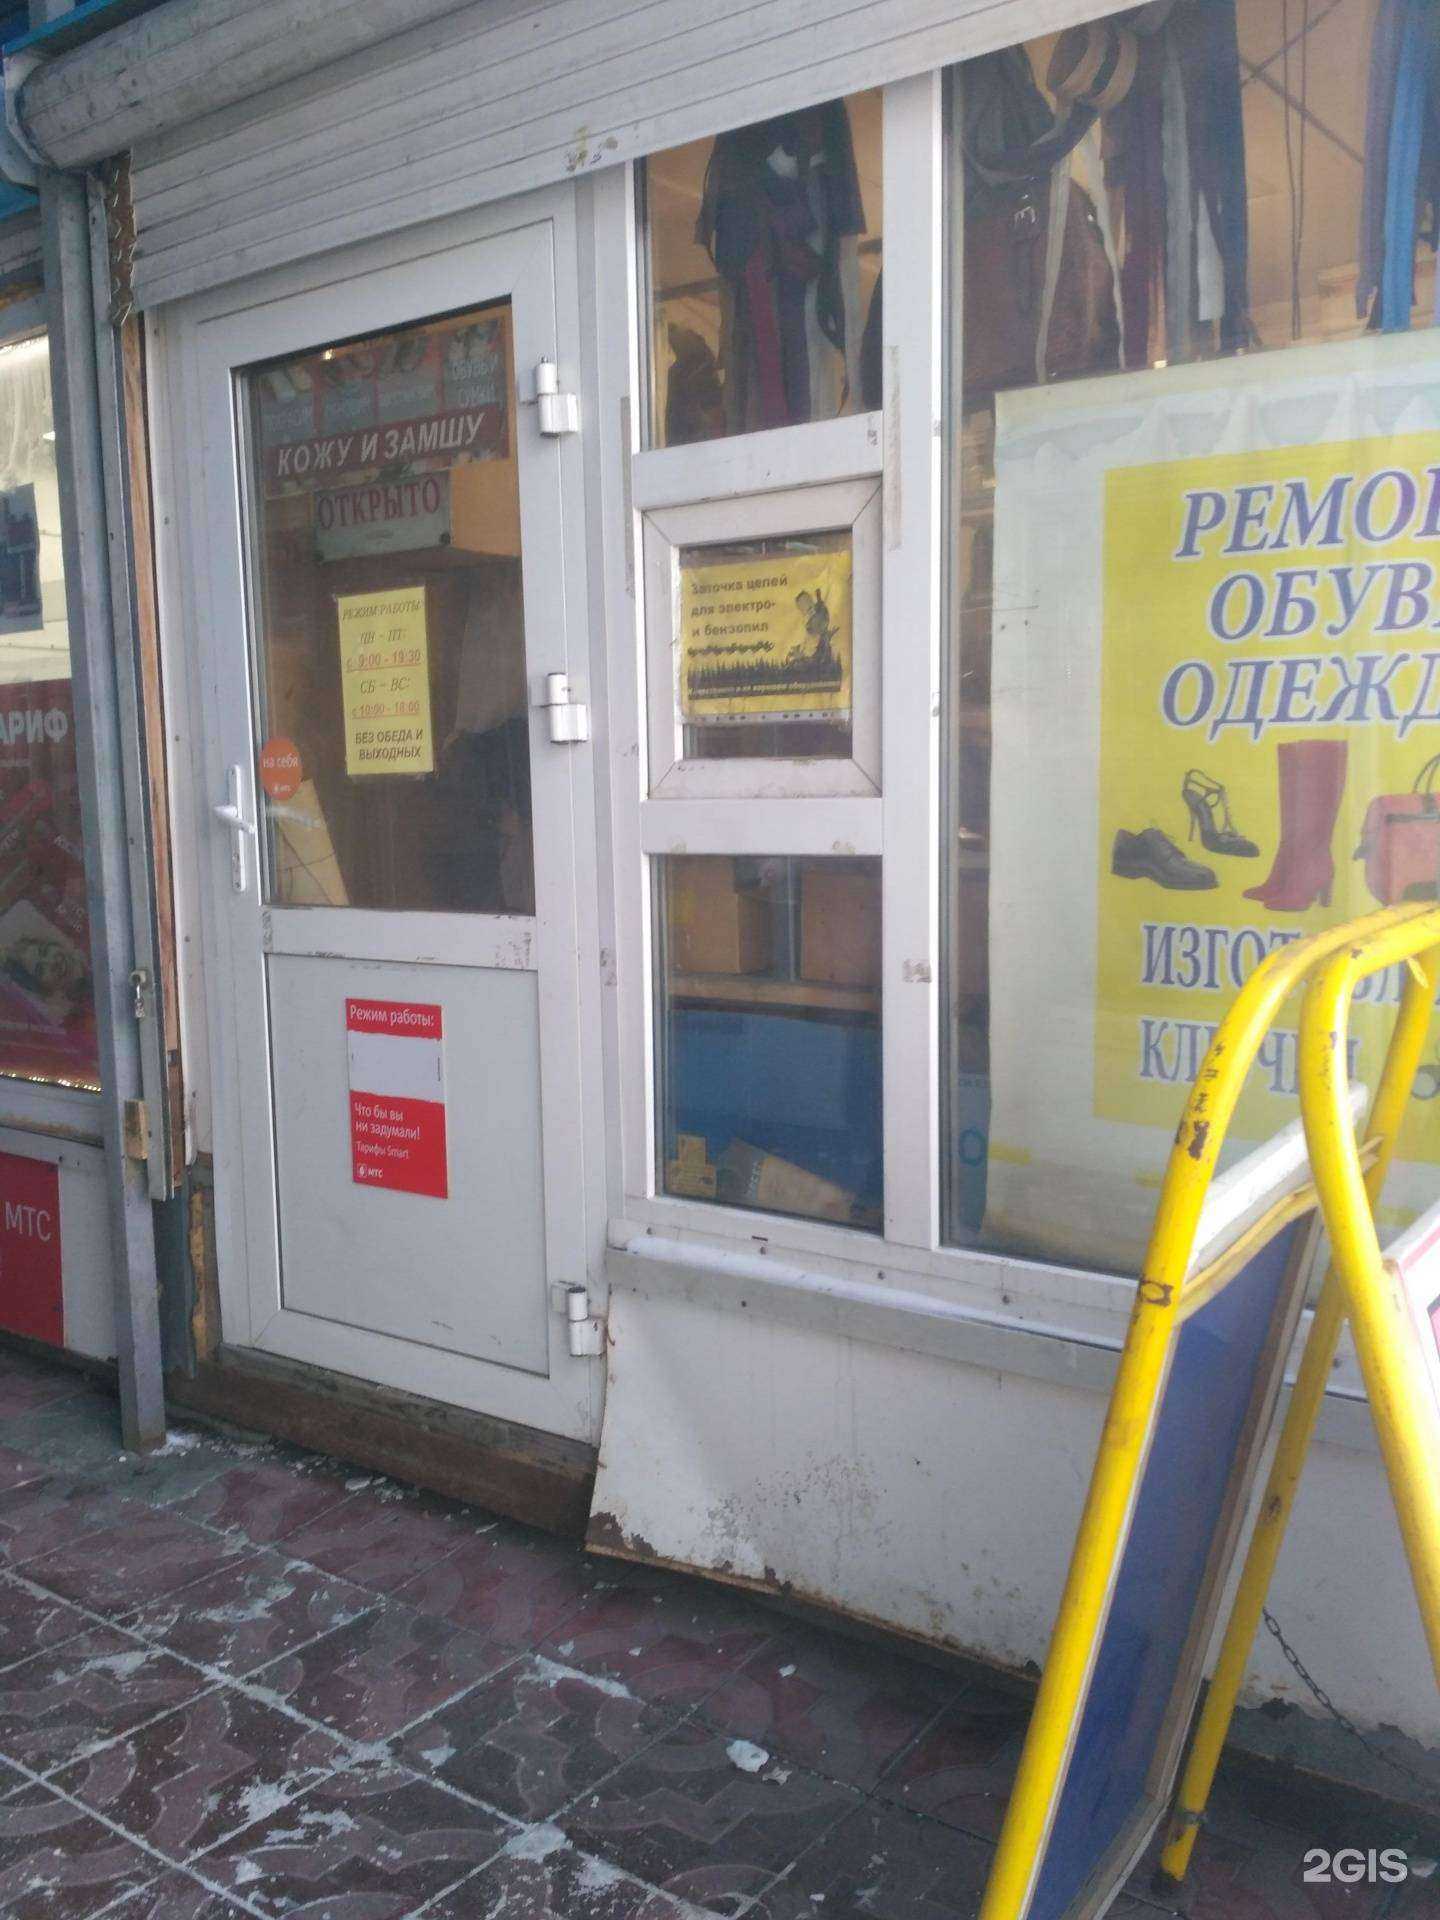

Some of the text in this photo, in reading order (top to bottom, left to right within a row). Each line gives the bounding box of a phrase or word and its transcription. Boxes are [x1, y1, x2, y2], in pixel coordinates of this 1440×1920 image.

[277, 413, 485, 477] КОЖУ И ЗАМШУ
[318, 478, 441, 530] ОТКРЫТО
[691, 575, 788, 595] Заточка цепей
[1210, 562, 1440, 640] ОБУВ
[691, 605, 715, 618] для
[691, 622, 769, 637] и бензопил
[360, 680, 376, 694] СБ
[355, 728, 424, 744] БЕЗ ОБЕДА И
[358, 746, 421, 762] ВЫХОДНЫХ
[350, 1004, 434, 1028] Режим работы:
[355, 1102, 403, 1121] Что бы вы
[356, 1120, 420, 1140] ни задумали!
[5, 1201, 51, 1242] МТС
